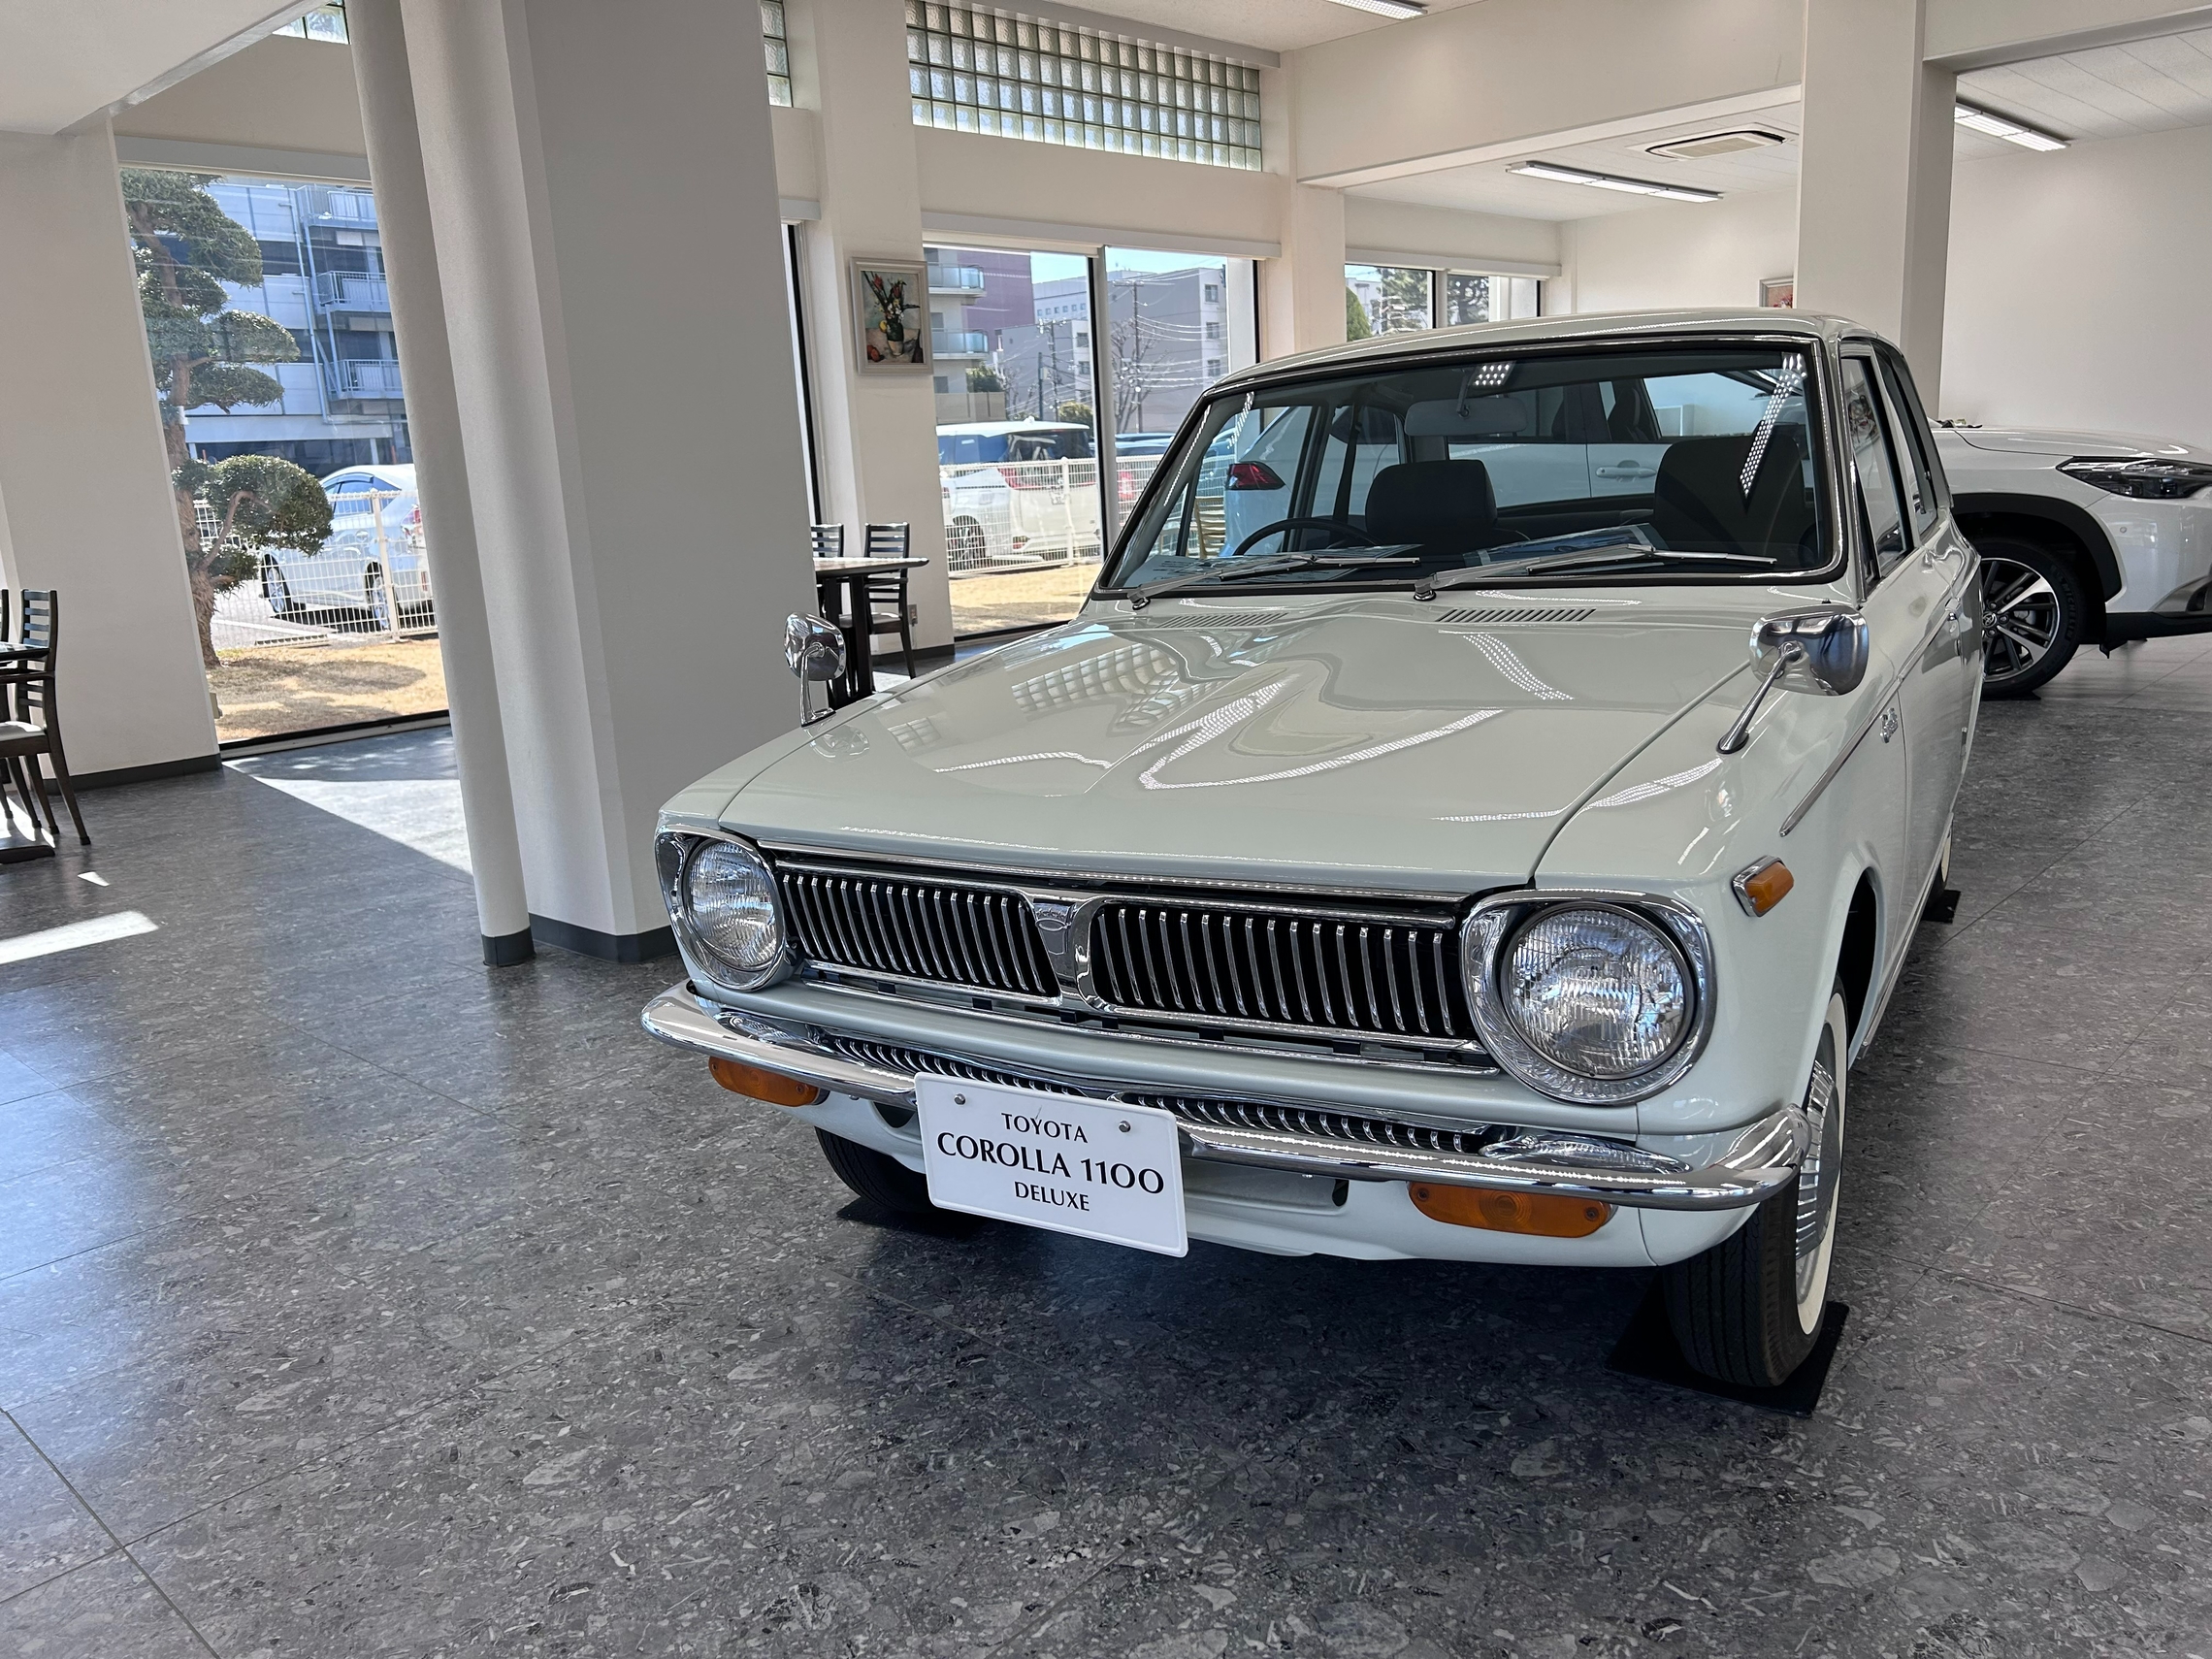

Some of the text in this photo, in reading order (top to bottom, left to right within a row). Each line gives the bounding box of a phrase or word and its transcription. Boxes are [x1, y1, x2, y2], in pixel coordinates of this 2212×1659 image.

[2063, 583, 2075, 638] MICHELIN
[1001, 1113, 1088, 1143] TOYOTA
[937, 1132, 1164, 1194] COROLLA 1100
[1014, 1182, 1090, 1211] DELUXE
